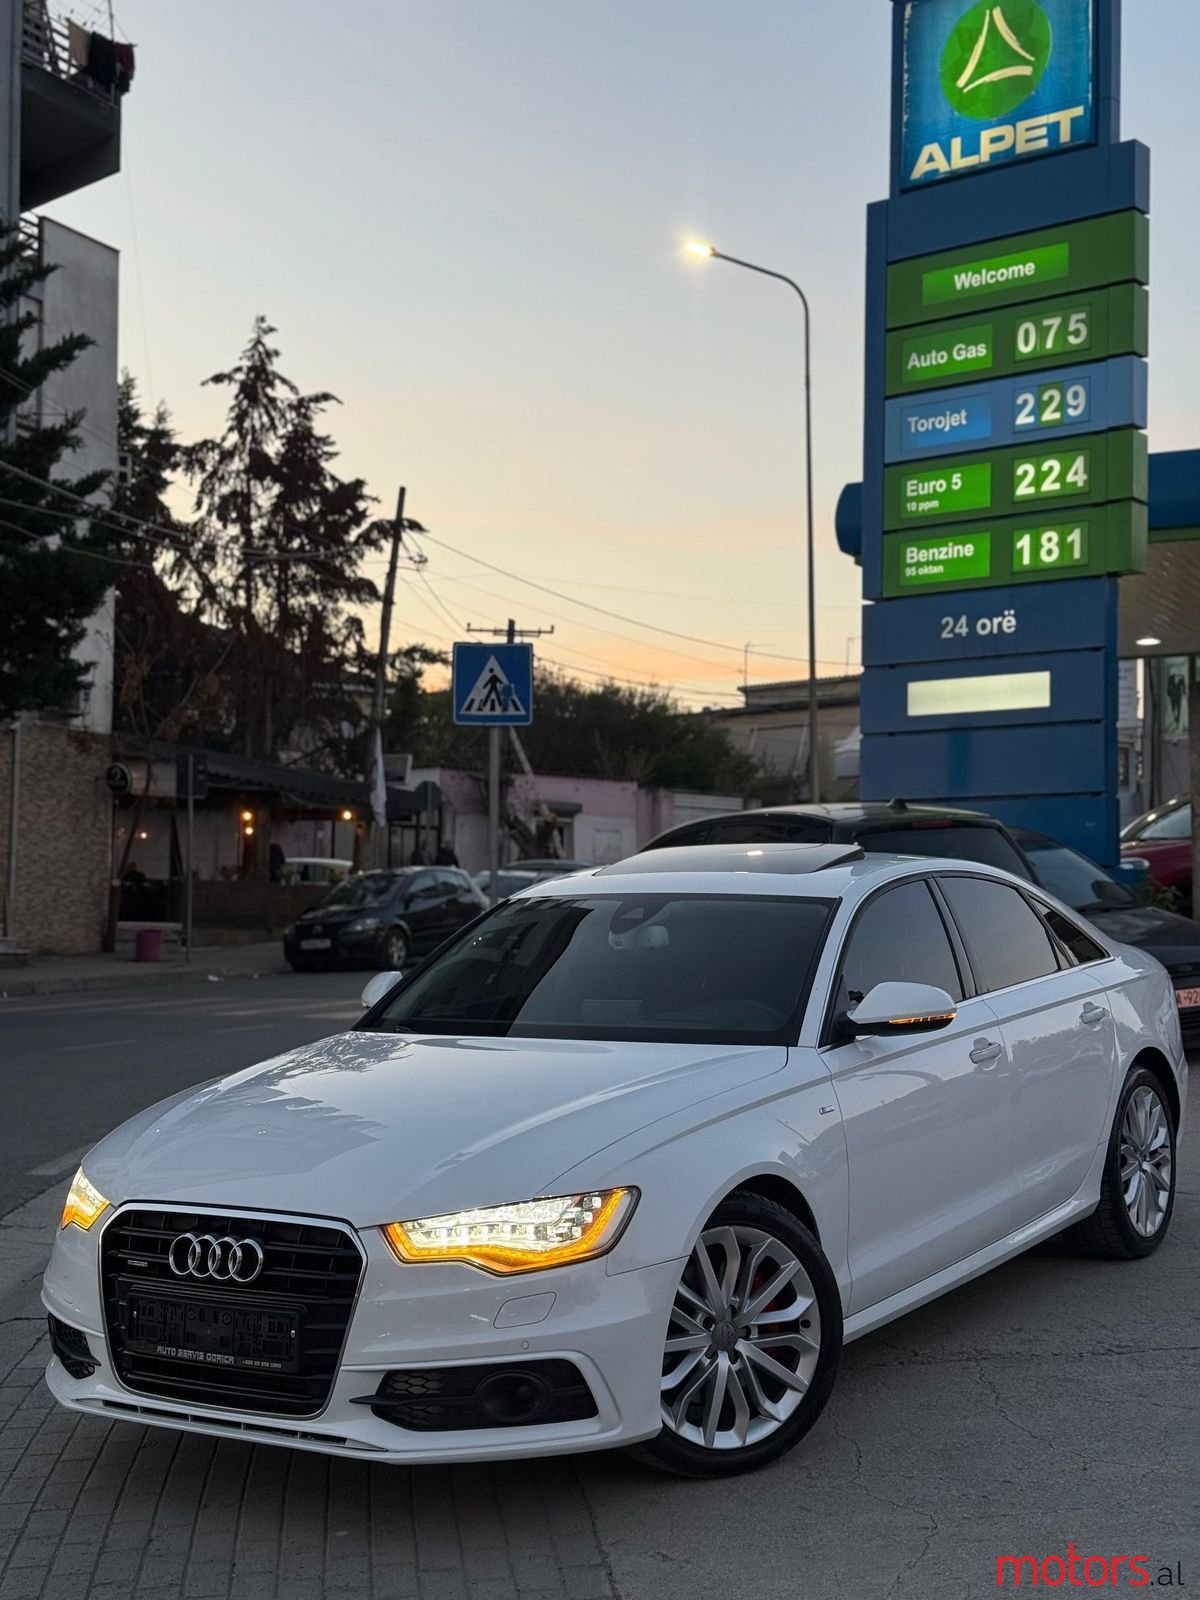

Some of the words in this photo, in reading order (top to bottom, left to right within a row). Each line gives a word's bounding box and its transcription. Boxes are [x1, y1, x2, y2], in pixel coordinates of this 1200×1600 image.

[910, 105, 1084, 180] ALPET
[953, 261, 1036, 291] Welcome
[1017, 313, 1087, 353] 075
[907, 350, 948, 370] Auto
[952, 343, 987, 361] Gas
[1015, 384, 1087, 425] 229
[907, 409, 968, 433] Torojet
[906, 479, 947, 497] Euro
[951, 472, 962, 490] 5
[1015, 455, 1088, 496] 224
[906, 501, 917, 512] 10
[918, 500, 939, 512] ppm
[906, 542, 975, 564] Benzine
[1015, 528, 1082, 566] 181
[940, 615, 969, 639] 24
[976, 610, 1017, 635] orë
[157, 1345, 177, 1356] AUTO
